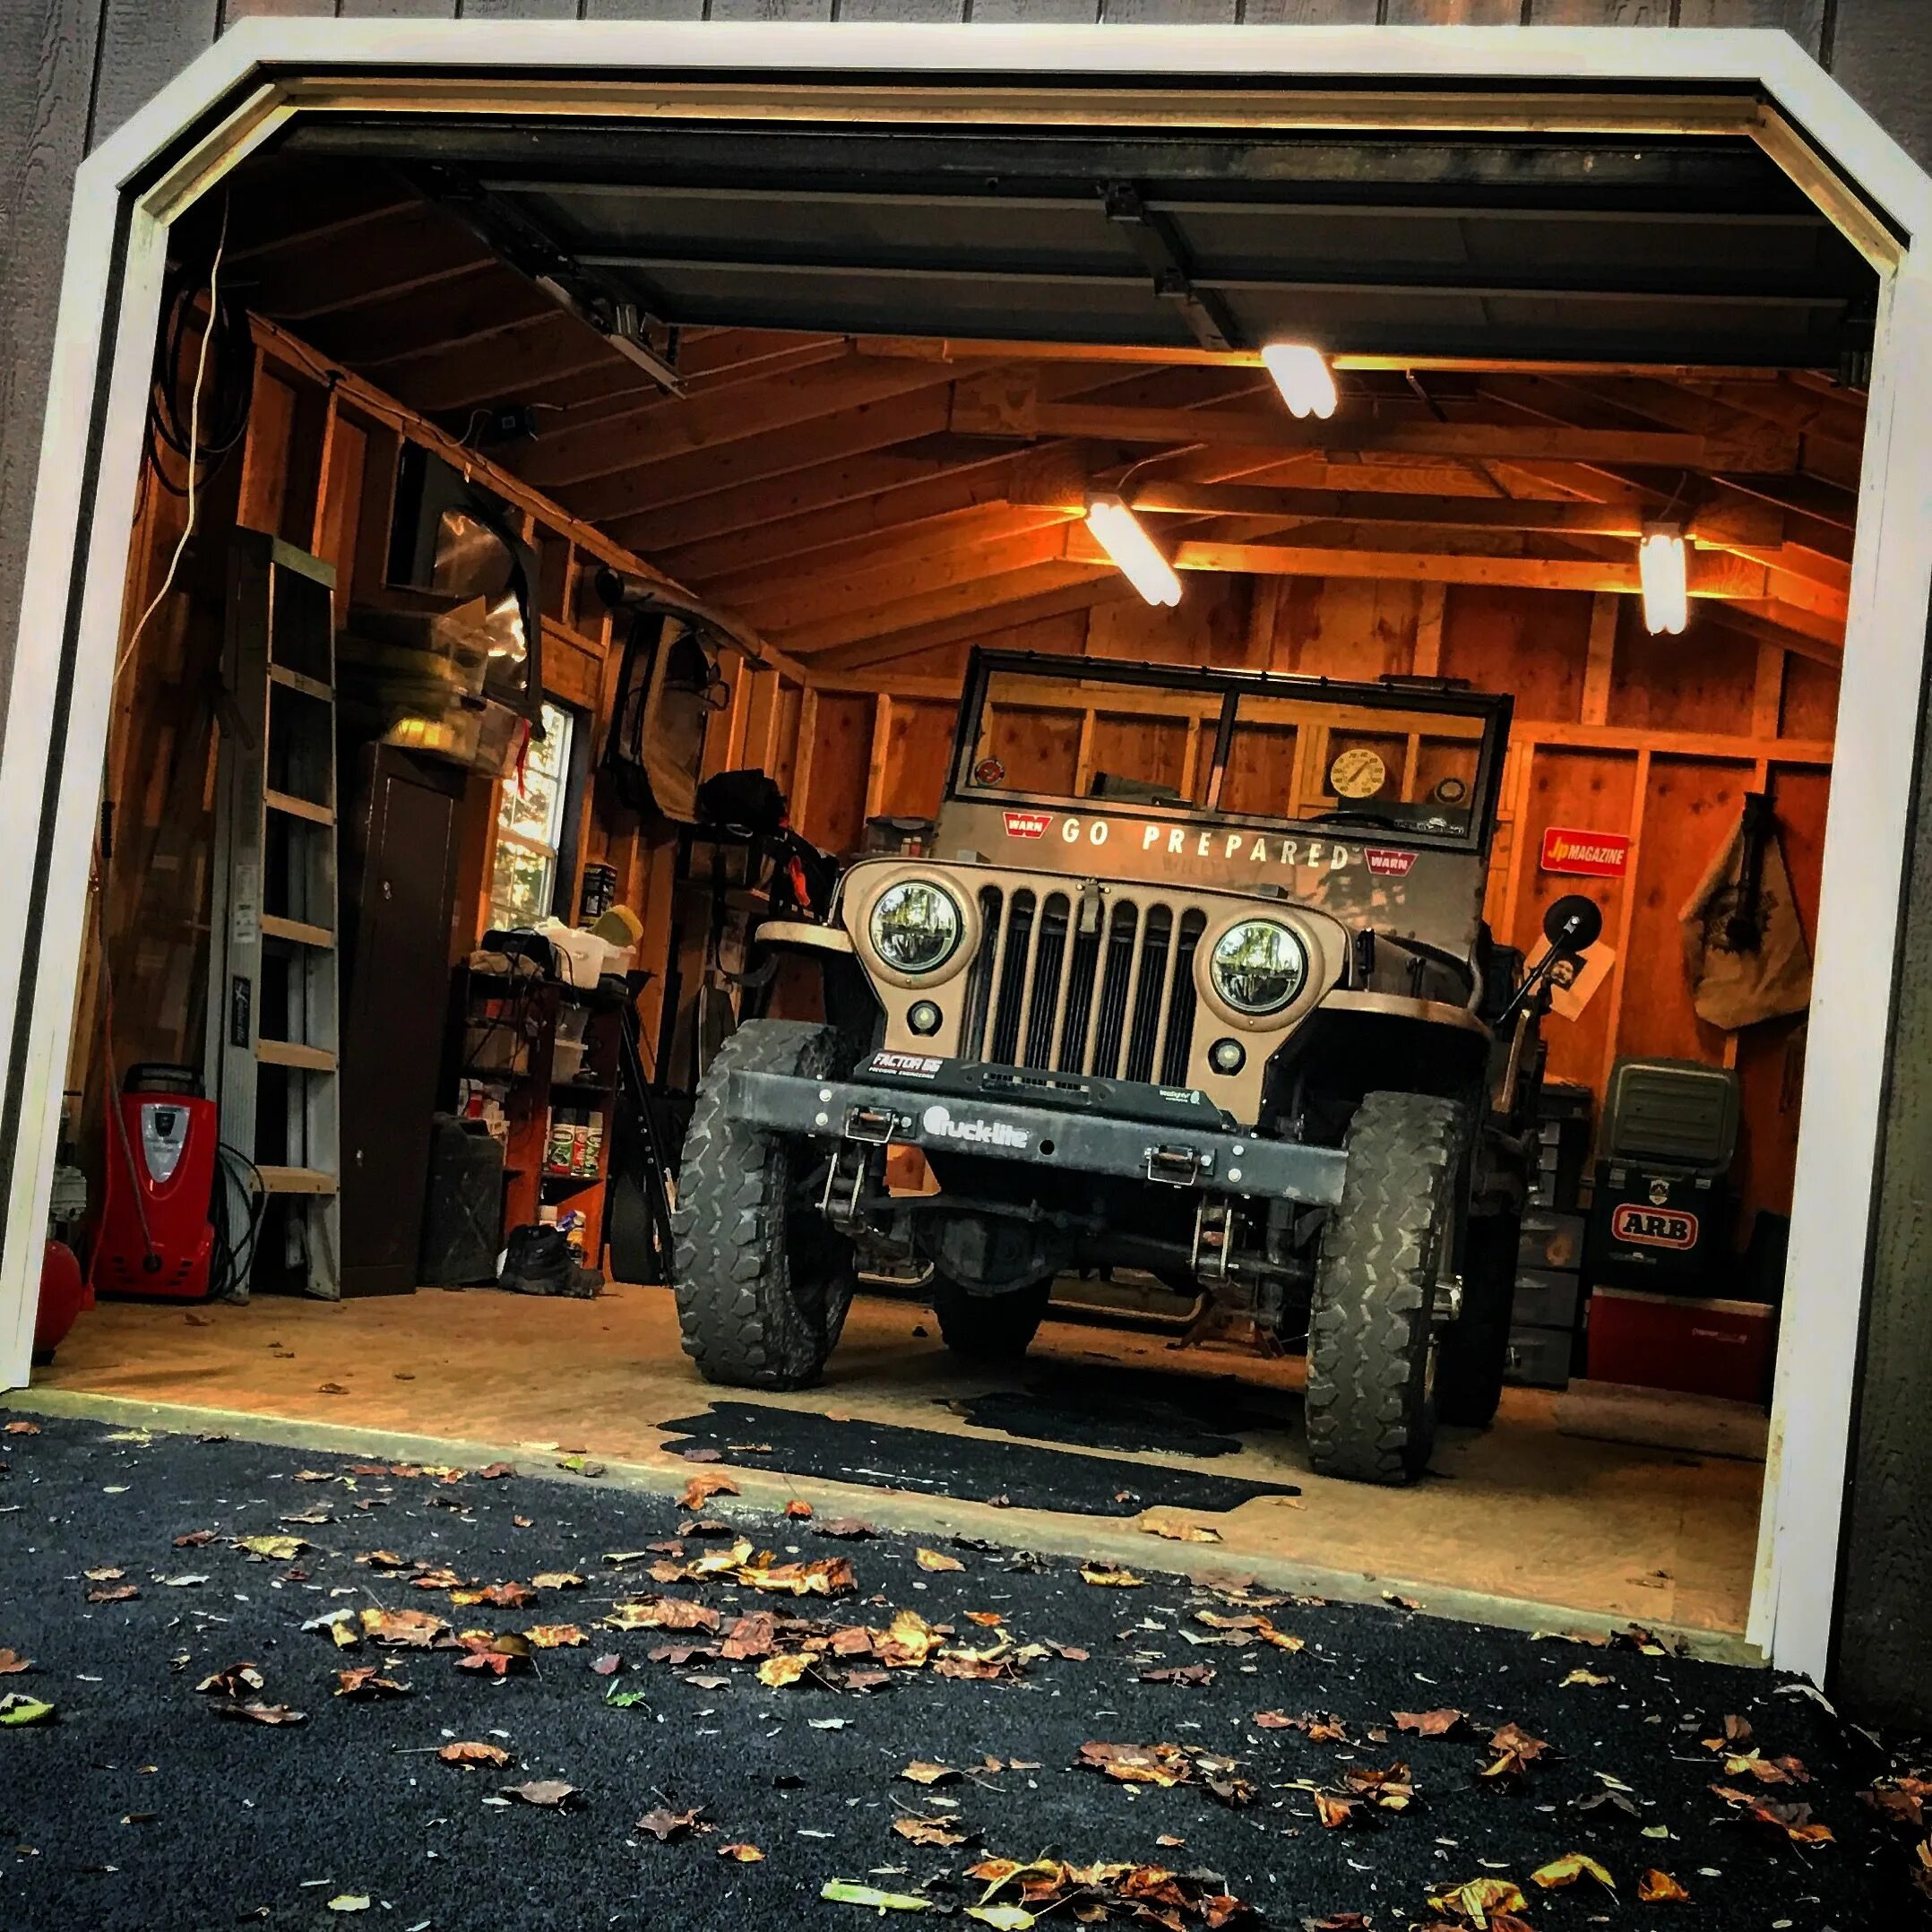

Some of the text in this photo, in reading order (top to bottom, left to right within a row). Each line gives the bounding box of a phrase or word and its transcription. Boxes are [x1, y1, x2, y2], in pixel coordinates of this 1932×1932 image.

[1009, 819, 1043, 832] WARN
[1062, 818, 1348, 869] GO PREPARED
[1371, 856, 1408, 870] WARN
[1568, 845, 1624, 865] MAGAZINE
[1622, 1212, 1688, 1241] ARB
